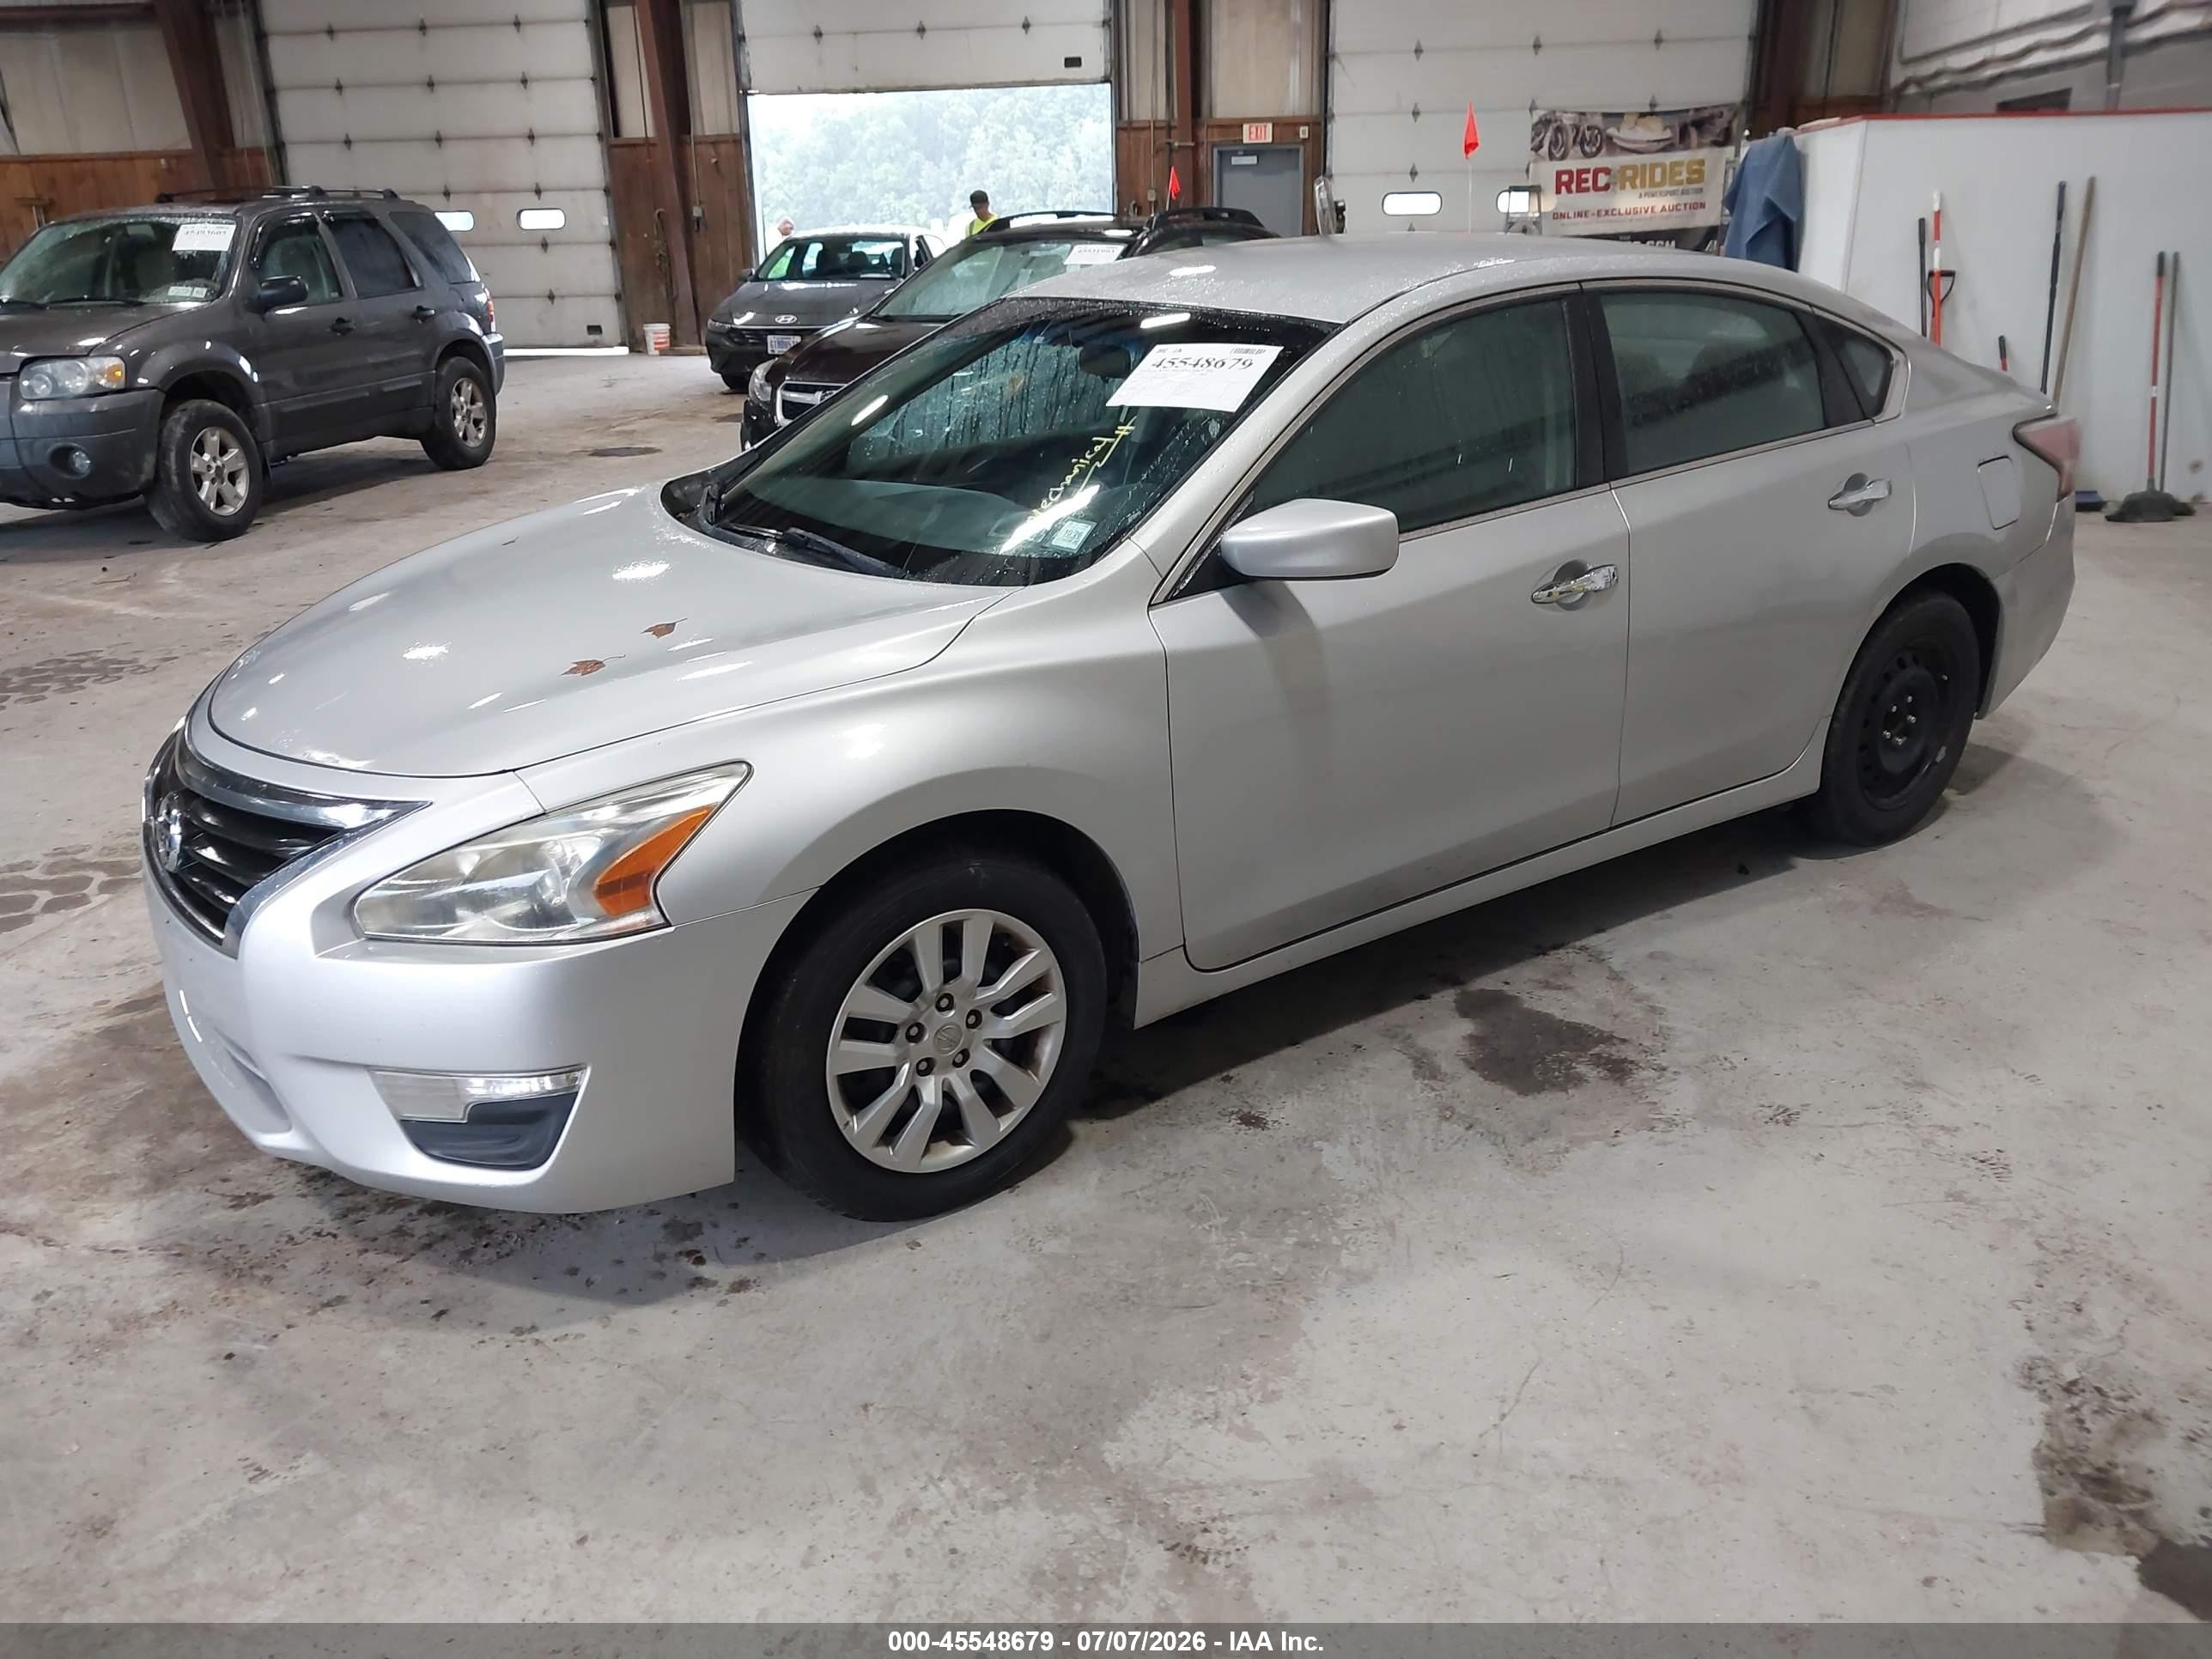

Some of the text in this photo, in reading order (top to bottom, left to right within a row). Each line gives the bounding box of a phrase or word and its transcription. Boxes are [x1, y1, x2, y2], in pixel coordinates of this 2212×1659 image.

[1249, 124, 1267, 141] EXIT
[1555, 158, 1705, 195] REC RIDES
[1553, 201, 1707, 221] ONLINE-EXCLUSIVE AUCTION
[1152, 357, 1254, 370] 45548679
